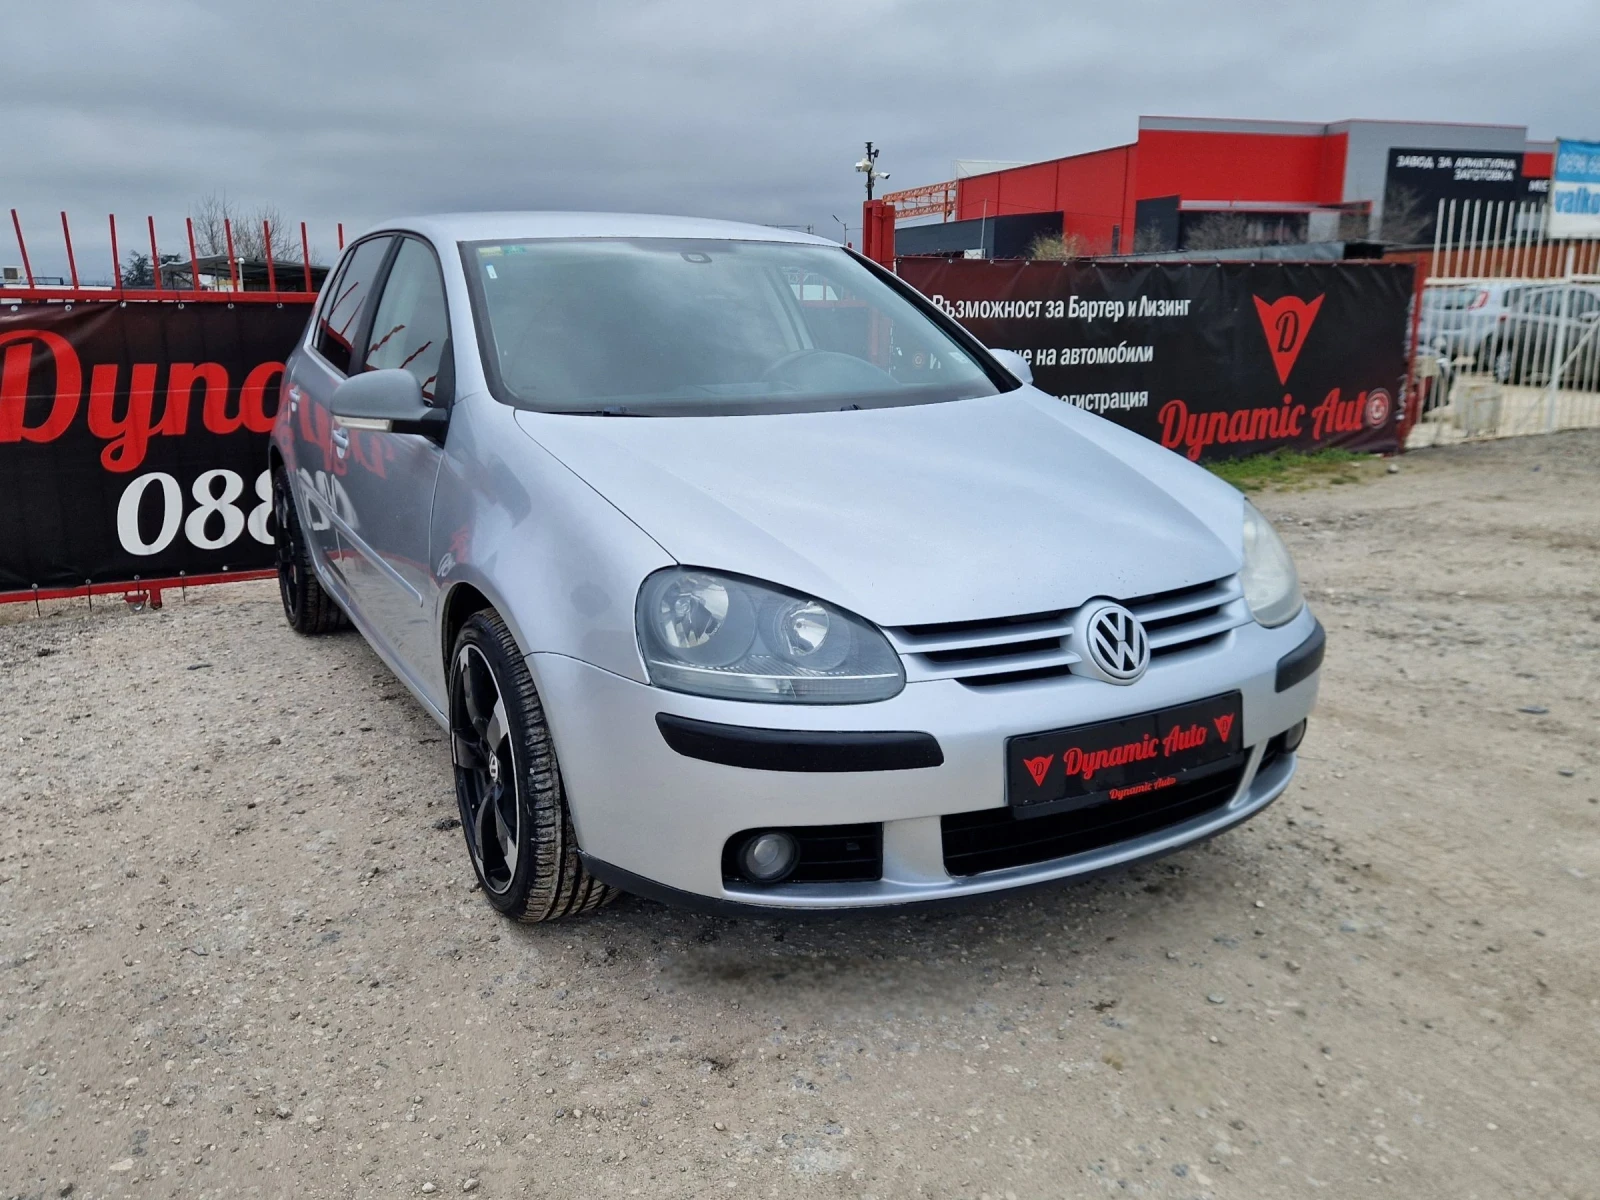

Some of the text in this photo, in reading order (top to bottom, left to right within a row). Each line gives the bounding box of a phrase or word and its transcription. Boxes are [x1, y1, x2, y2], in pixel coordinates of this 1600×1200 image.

[1396, 155, 1434, 169] ЗАВОД
[1438, 156, 1453, 169] ЗА
[932, 294, 1192, 323] Възможност за Бартер и Лизинг
[1036, 347, 1057, 366] на
[1060, 340, 1154, 365] автомобили
[1054, 391, 1149, 414] гистрация
[1158, 393, 1305, 462] Dynamic
[1063, 733, 1159, 780] Dynamic
[1163, 725, 1207, 757] Auto
[1109, 776, 1177, 801] Dynamic Auto
